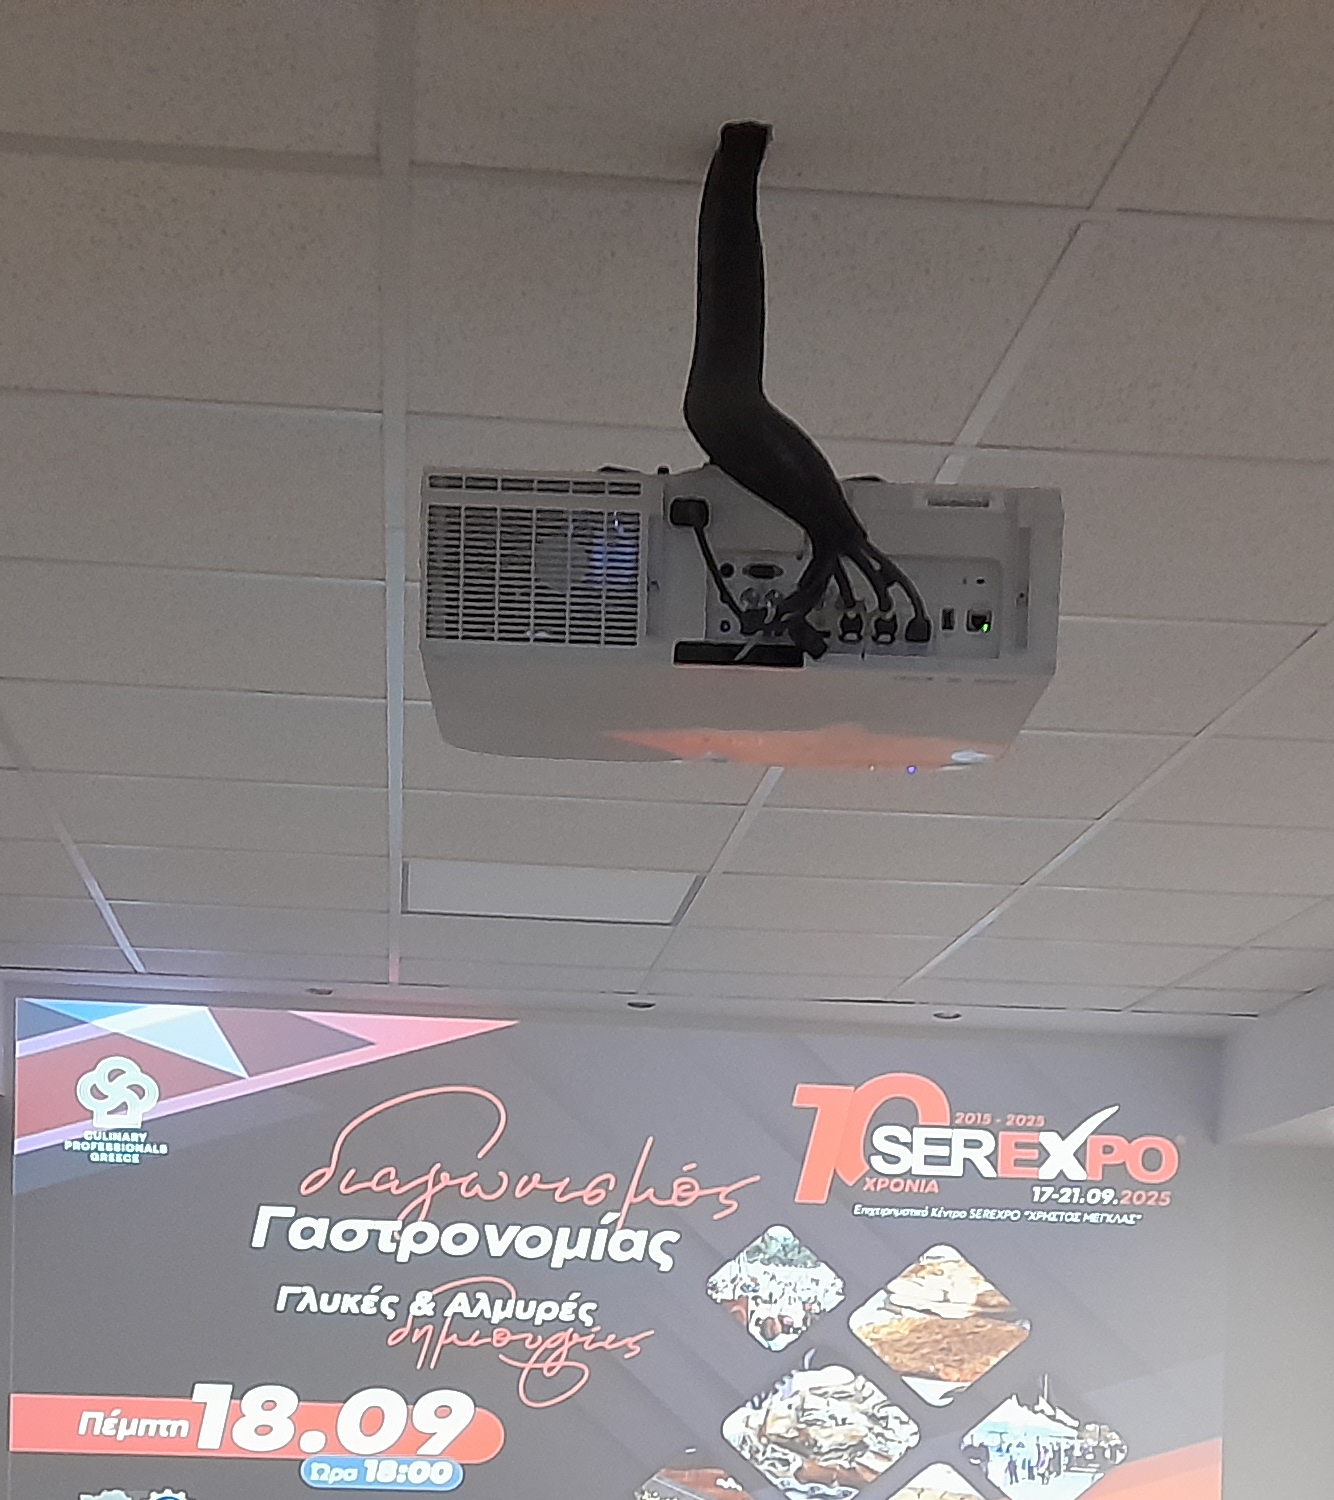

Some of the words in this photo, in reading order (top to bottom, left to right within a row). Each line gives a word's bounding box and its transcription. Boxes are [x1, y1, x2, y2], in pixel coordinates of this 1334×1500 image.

[954, 1112, 992, 1125] 2015
[1006, 1114, 1046, 1127] 2025
[64, 1140, 167, 1154] PROFESSIONALS
[83, 1130, 147, 1142] CULINARY
[870, 1104, 1179, 1185] SEREXPO
[89, 1152, 140, 1163] GREECE
[299, 1085, 761, 1238] διαγωνισμός
[863, 1177, 940, 1194] ΧΡΟΝΙΑ
[930, 1206, 967, 1220] Κέντρο
[969, 1208, 1021, 1221] SEREXPO
[250, 1204, 681, 1271] Γαστρονομίας
[275, 1284, 400, 1320] Γλυκές
[409, 1290, 435, 1317] &
[443, 1290, 598, 1326] Αλμυρές
[77, 1408, 190, 1440] Πέμπτη
[190, 1382, 475, 1455] 18.09
[363, 1458, 455, 1485] 18:00
